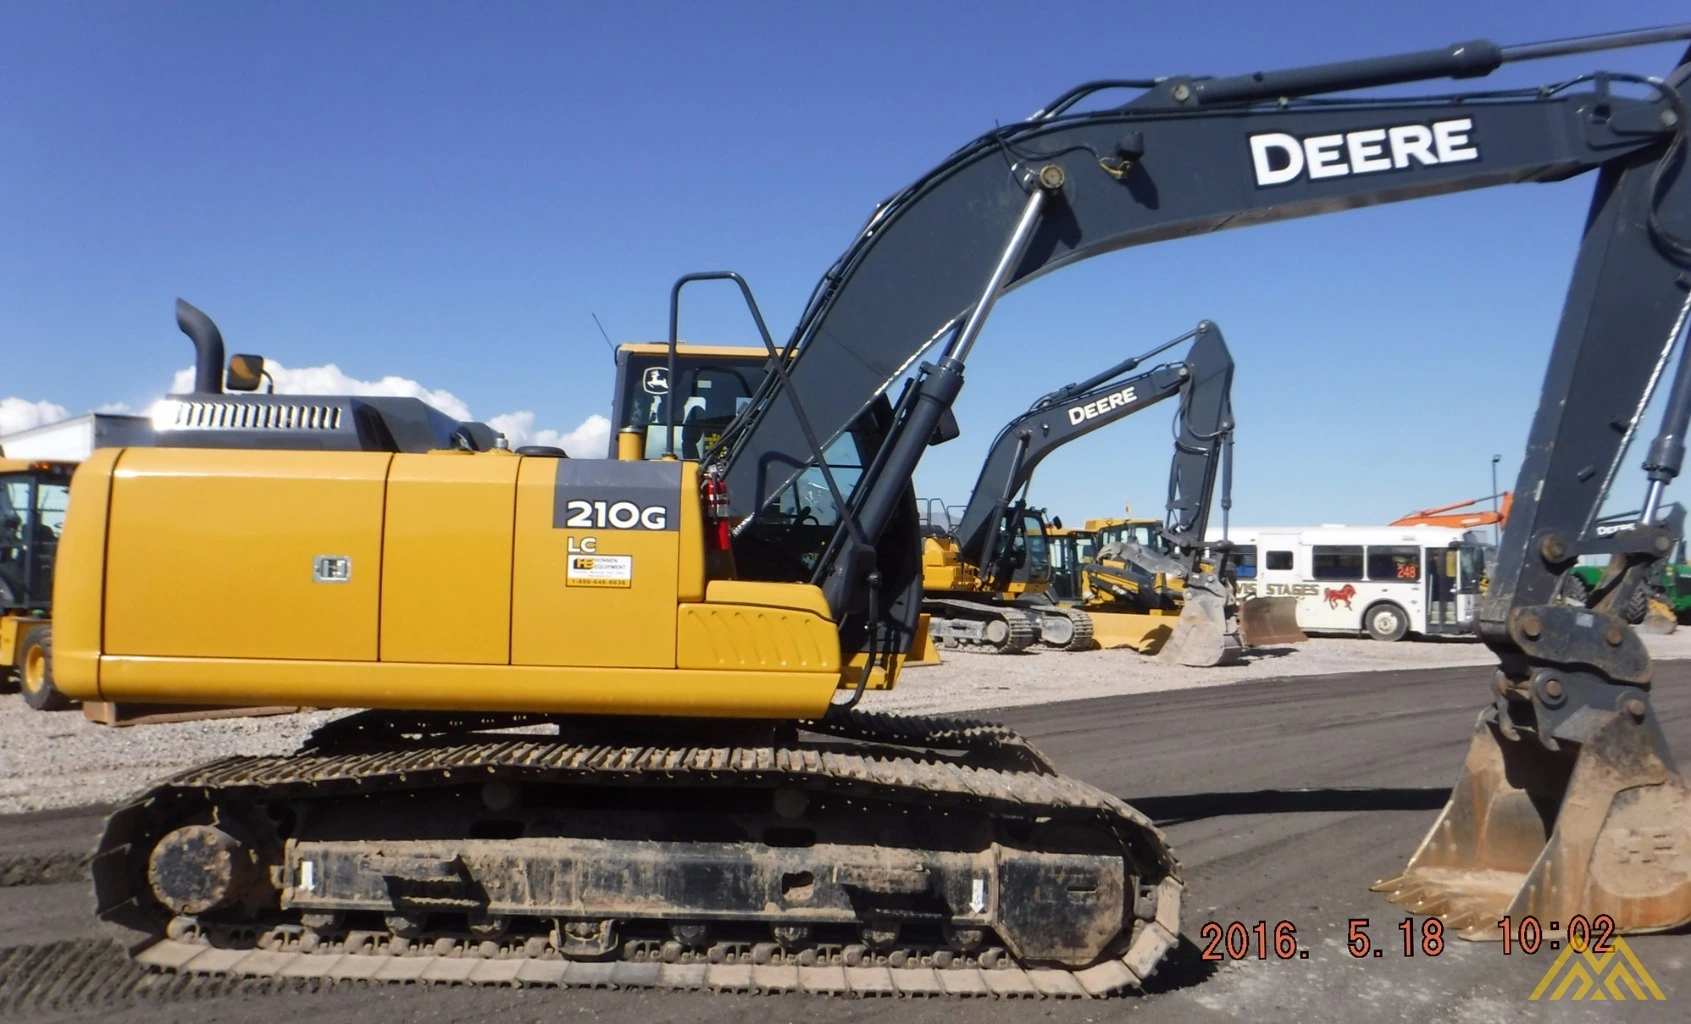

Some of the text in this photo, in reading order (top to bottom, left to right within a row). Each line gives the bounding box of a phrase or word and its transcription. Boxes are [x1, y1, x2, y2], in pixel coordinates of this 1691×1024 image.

[1249, 118, 1479, 186] DEERE
[1068, 386, 1138, 426] DEERE
[566, 500, 667, 530] 210G
[567, 536, 597, 554] LC
[1396, 565, 1416, 579] 248
[1266, 583, 1319, 595] STAGES
